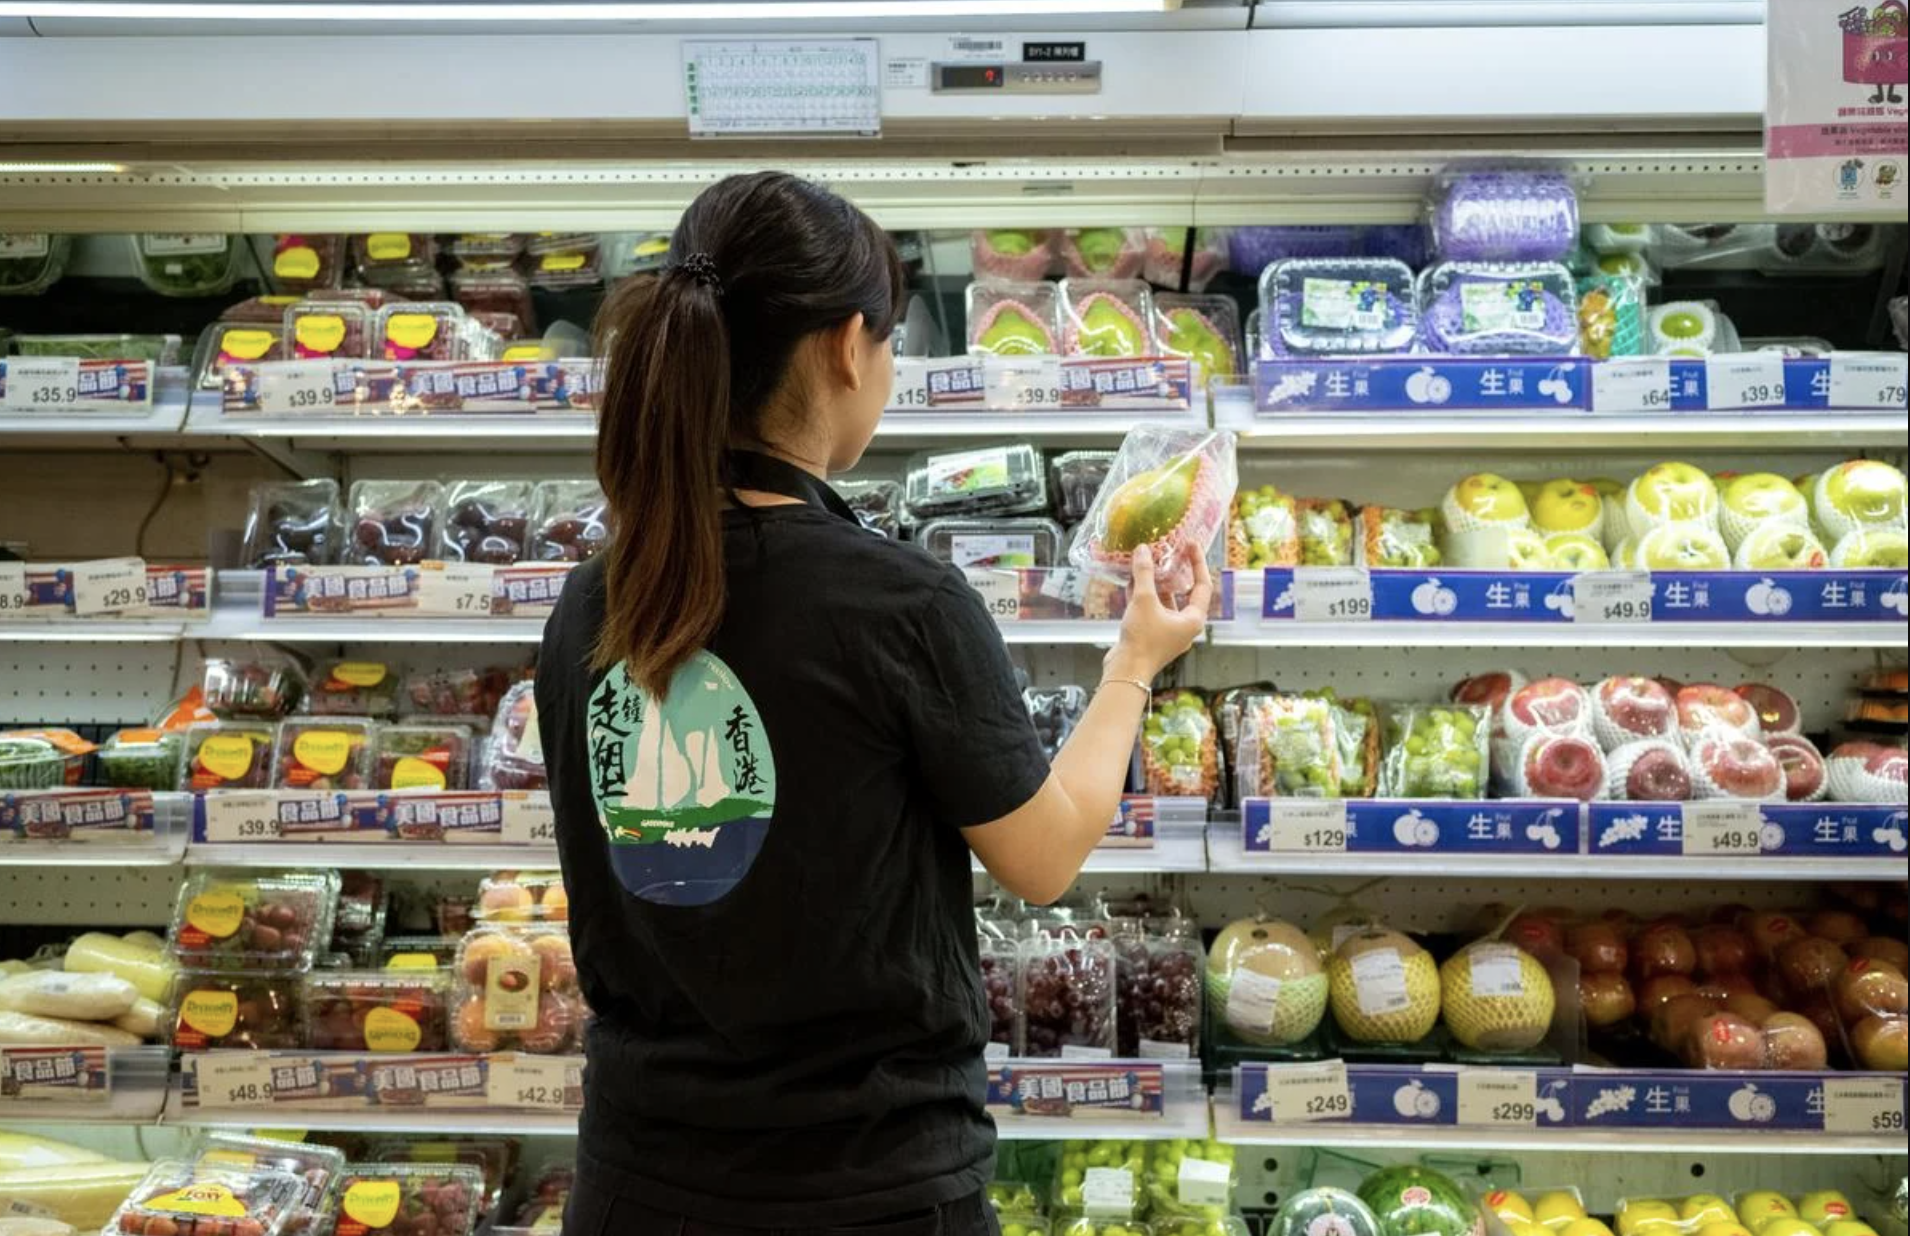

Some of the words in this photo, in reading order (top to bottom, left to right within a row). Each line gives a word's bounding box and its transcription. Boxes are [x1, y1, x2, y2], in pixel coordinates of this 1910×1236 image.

[33, 387, 76, 402] $35.9
[289, 387, 333, 407] $39.9
[1017, 388, 1060, 403] $39.9
[1642, 388, 1670, 405] $64
[1741, 384, 1785, 403] $39.9
[103, 588, 147, 607] $29.9
[456, 593, 490, 610] $7.5
[990, 599, 1017, 615] $59
[1329, 598, 1370, 616] $199
[1604, 601, 1650, 619] $49.9
[725, 705, 768, 795] 香港
[239, 820, 280, 837] $39.9
[1304, 831, 1344, 847] $129
[1713, 831, 1759, 848] $49.9
[229, 1083, 273, 1101] $48.9
[518, 1087, 563, 1103] $42.9
[1306, 1095, 1347, 1113] $249
[1493, 1103, 1535, 1120] $299
[1872, 1112, 1903, 1129] $59
